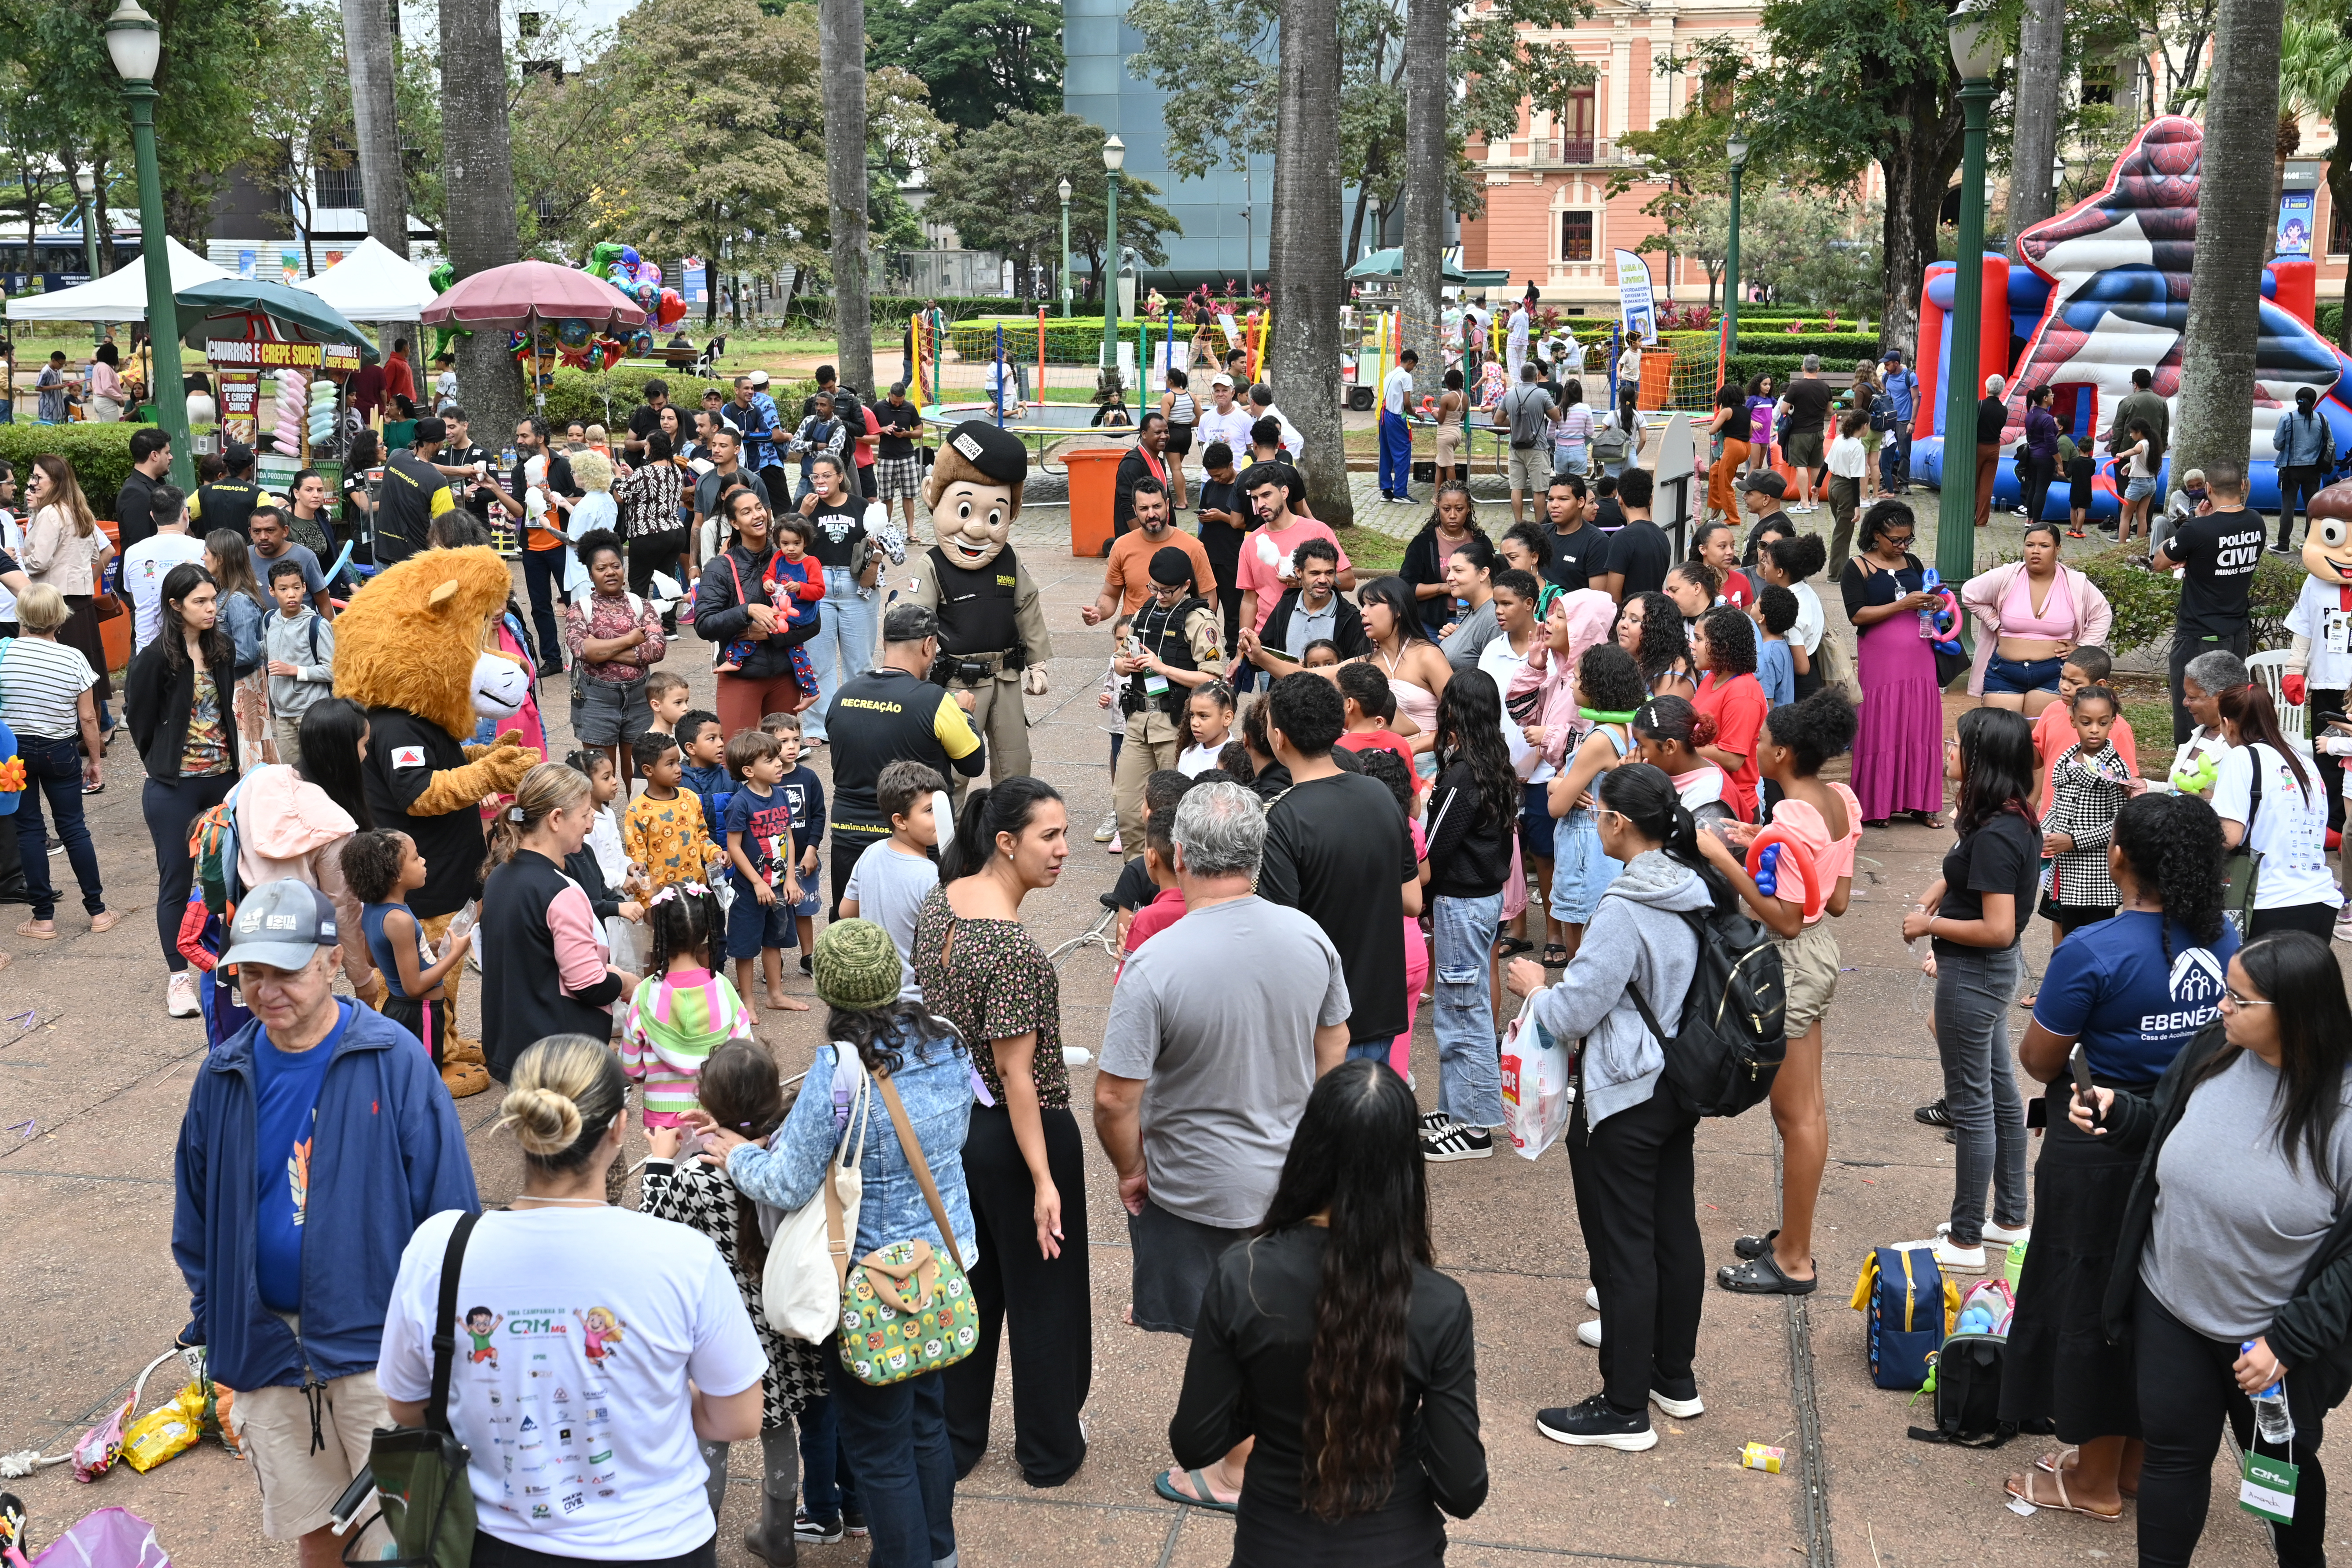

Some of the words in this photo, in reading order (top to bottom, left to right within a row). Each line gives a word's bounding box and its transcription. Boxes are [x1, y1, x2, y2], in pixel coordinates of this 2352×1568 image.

[1622, 275, 1645, 284] LIVRO!
[208, 341, 253, 363] CHURROS
[254, 343, 260, 363] E
[262, 343, 290, 364] CREPE
[292, 345, 321, 369] SUIÇO
[327, 344, 353, 357] CHURROS
[353, 347, 357, 358] E
[326, 356, 341, 368] CREPE
[342, 358, 360, 371] SUIÇO
[221, 383, 257, 393] CHURROS
[226, 393, 230, 401] E
[231, 393, 253, 402] CREPE
[228, 402, 250, 412] SUIÇO
[957, 438, 976, 457] MILITAR
[961, 435, 980, 453] POLÍCIA
[268, 473, 294, 481] PRODUTIVA
[389, 466, 418, 487] RECREAÇÃO
[818, 514, 855, 528] MALIBU
[2219, 530, 2261, 548] POLÍCIA
[2217, 546, 2258, 567] CIVIL
[2239, 563, 2256, 573] GERAIS
[841, 698, 902, 713] RECREAÇÃO
[749, 806, 789, 825] STAR
[283, 914, 296, 924] ITÁ
[509, 1318, 550, 1334] CRM
[2251, 1467, 2279, 1482] CRM
[565, 1498, 583, 1510] CIVIL
[2249, 1491, 2280, 1507] Amanda
